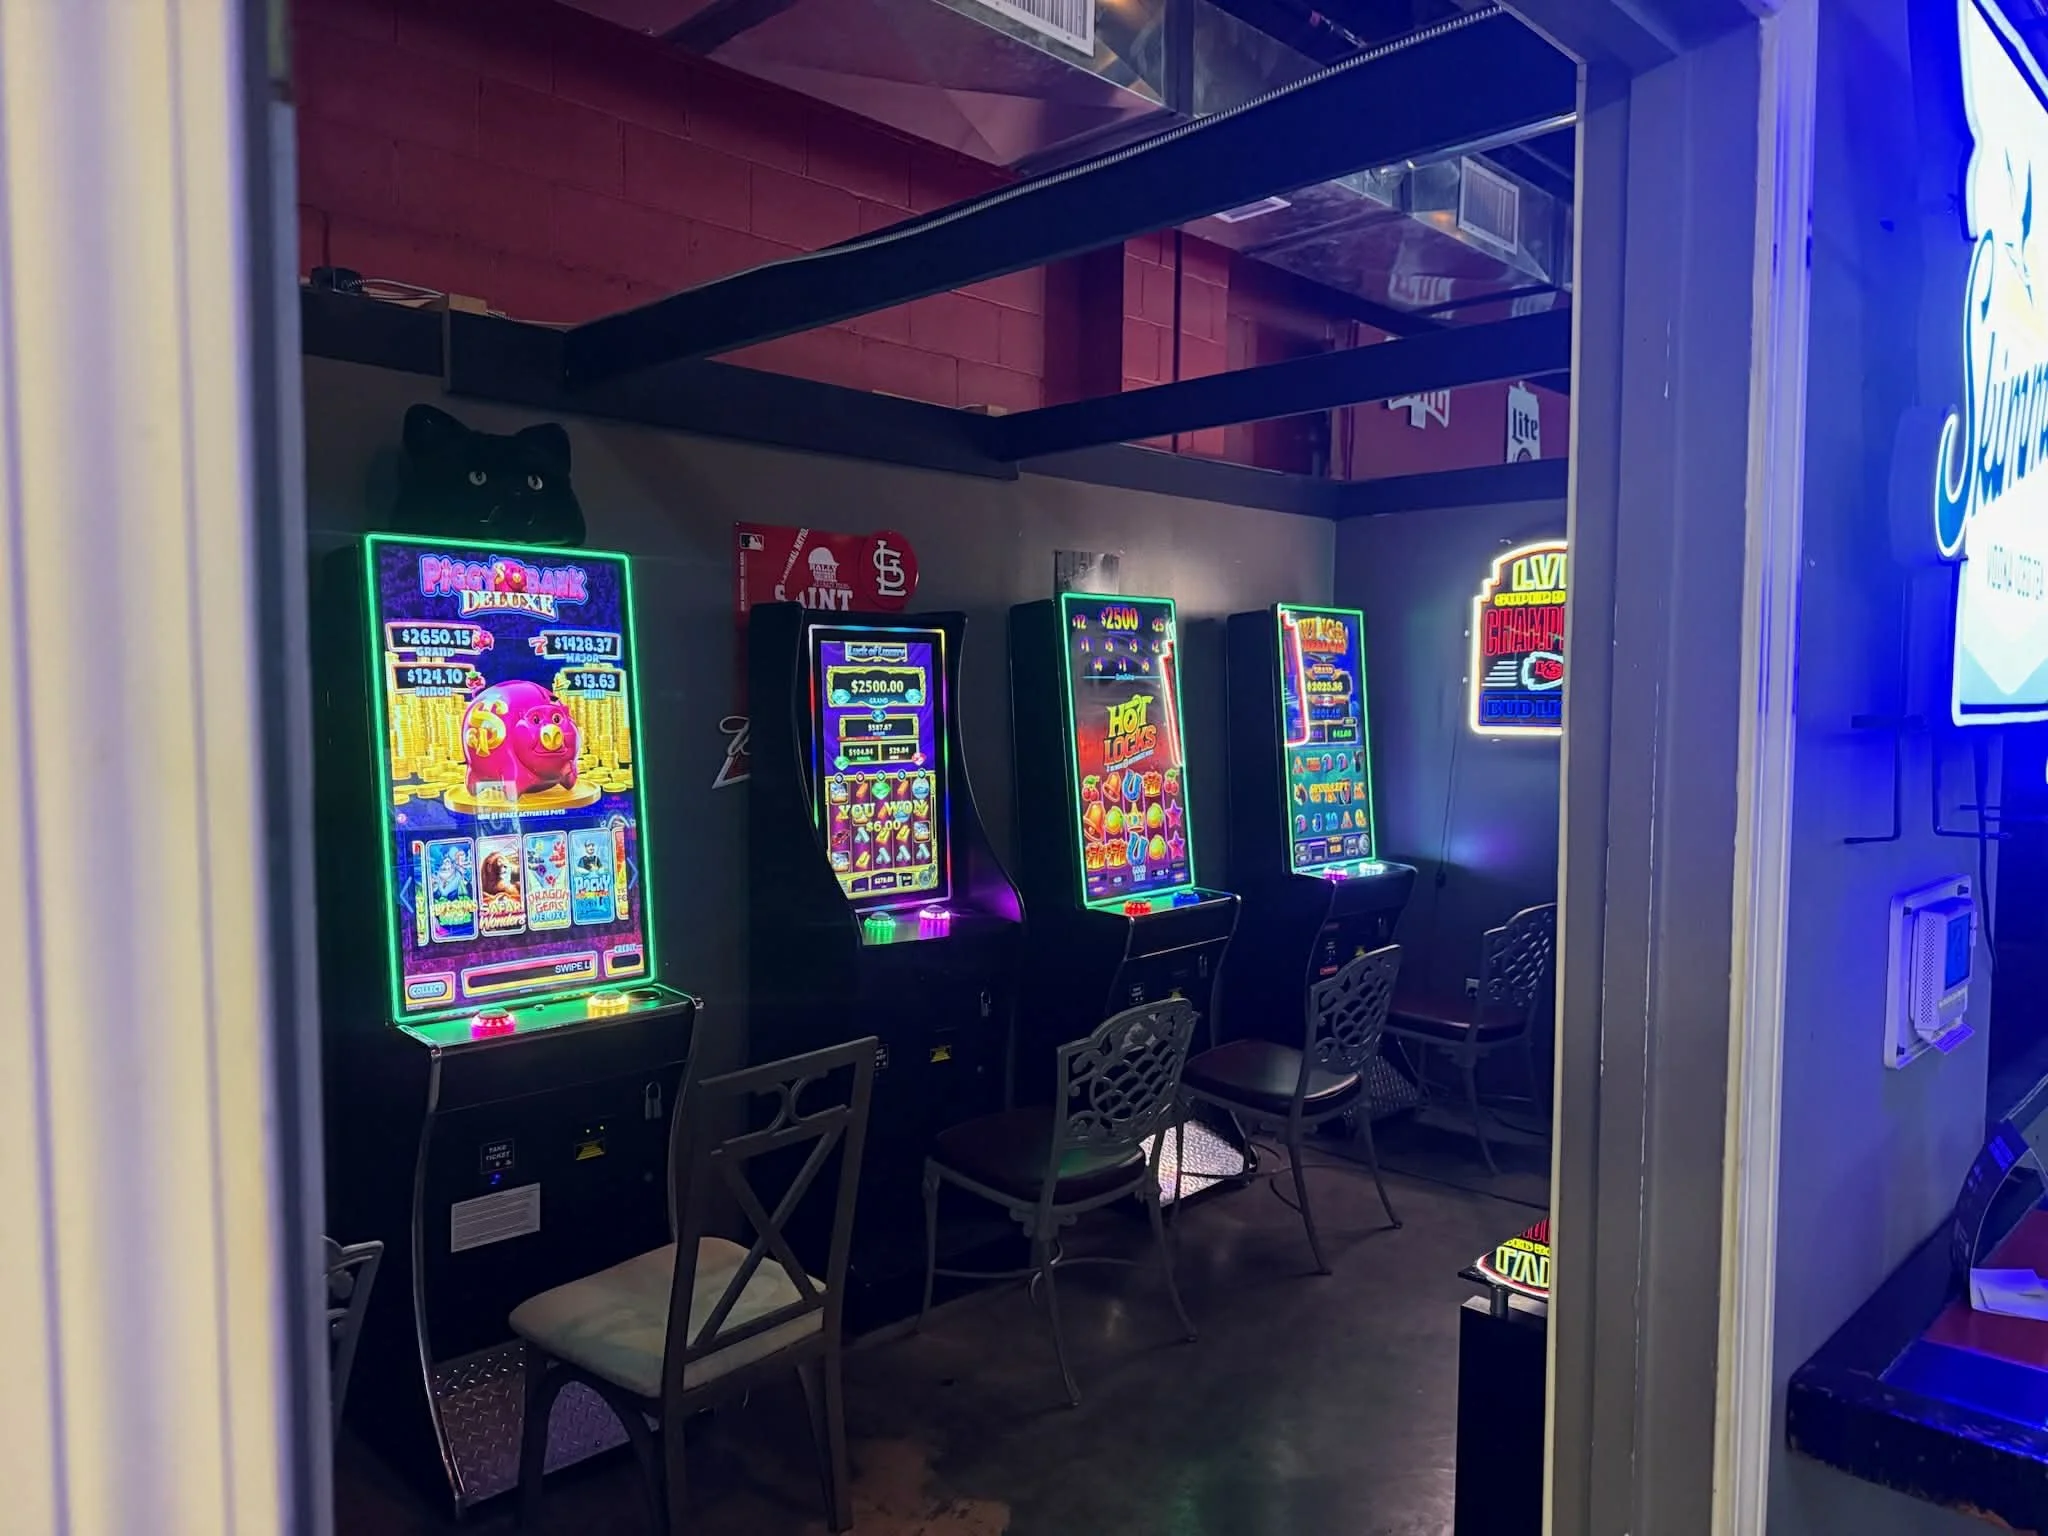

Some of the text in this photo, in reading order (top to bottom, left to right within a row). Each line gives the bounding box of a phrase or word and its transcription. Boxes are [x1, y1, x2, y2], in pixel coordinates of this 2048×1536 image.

[1511, 407, 1539, 445] Lite
[525, 566, 587, 602] BANK
[460, 589, 556, 618] DELUXE
[1494, 592, 1552, 607] SUPER
[1101, 607, 1139, 630] $2500
[401, 628, 471, 646] $2650.15
[554, 635, 613, 654] $1428.37
[415, 646, 456, 657] GRAND
[565, 653, 600, 664] MAJOR
[407, 668, 463, 685] $124.10
[574, 673, 616, 690] $13.63
[415, 686, 452, 697] MINOR
[851, 679, 904, 695] $2500.00
[1106, 694, 1154, 737] HOT
[1487, 699, 1535, 718] BUD
[1104, 724, 1157, 767] LOCKS
[838, 799, 929, 820] YOU WON
[865, 820, 901, 832] $6.00
[527, 888, 569, 903] DRAGON
[479, 913, 526, 931] Wonders
[532, 911, 566, 922] DELUXE
[554, 961, 583, 974] SWIPE
[411, 985, 443, 996] COLLECT
[485, 1150, 511, 1161] TICKET
[488, 1144, 508, 1154] TAKE
